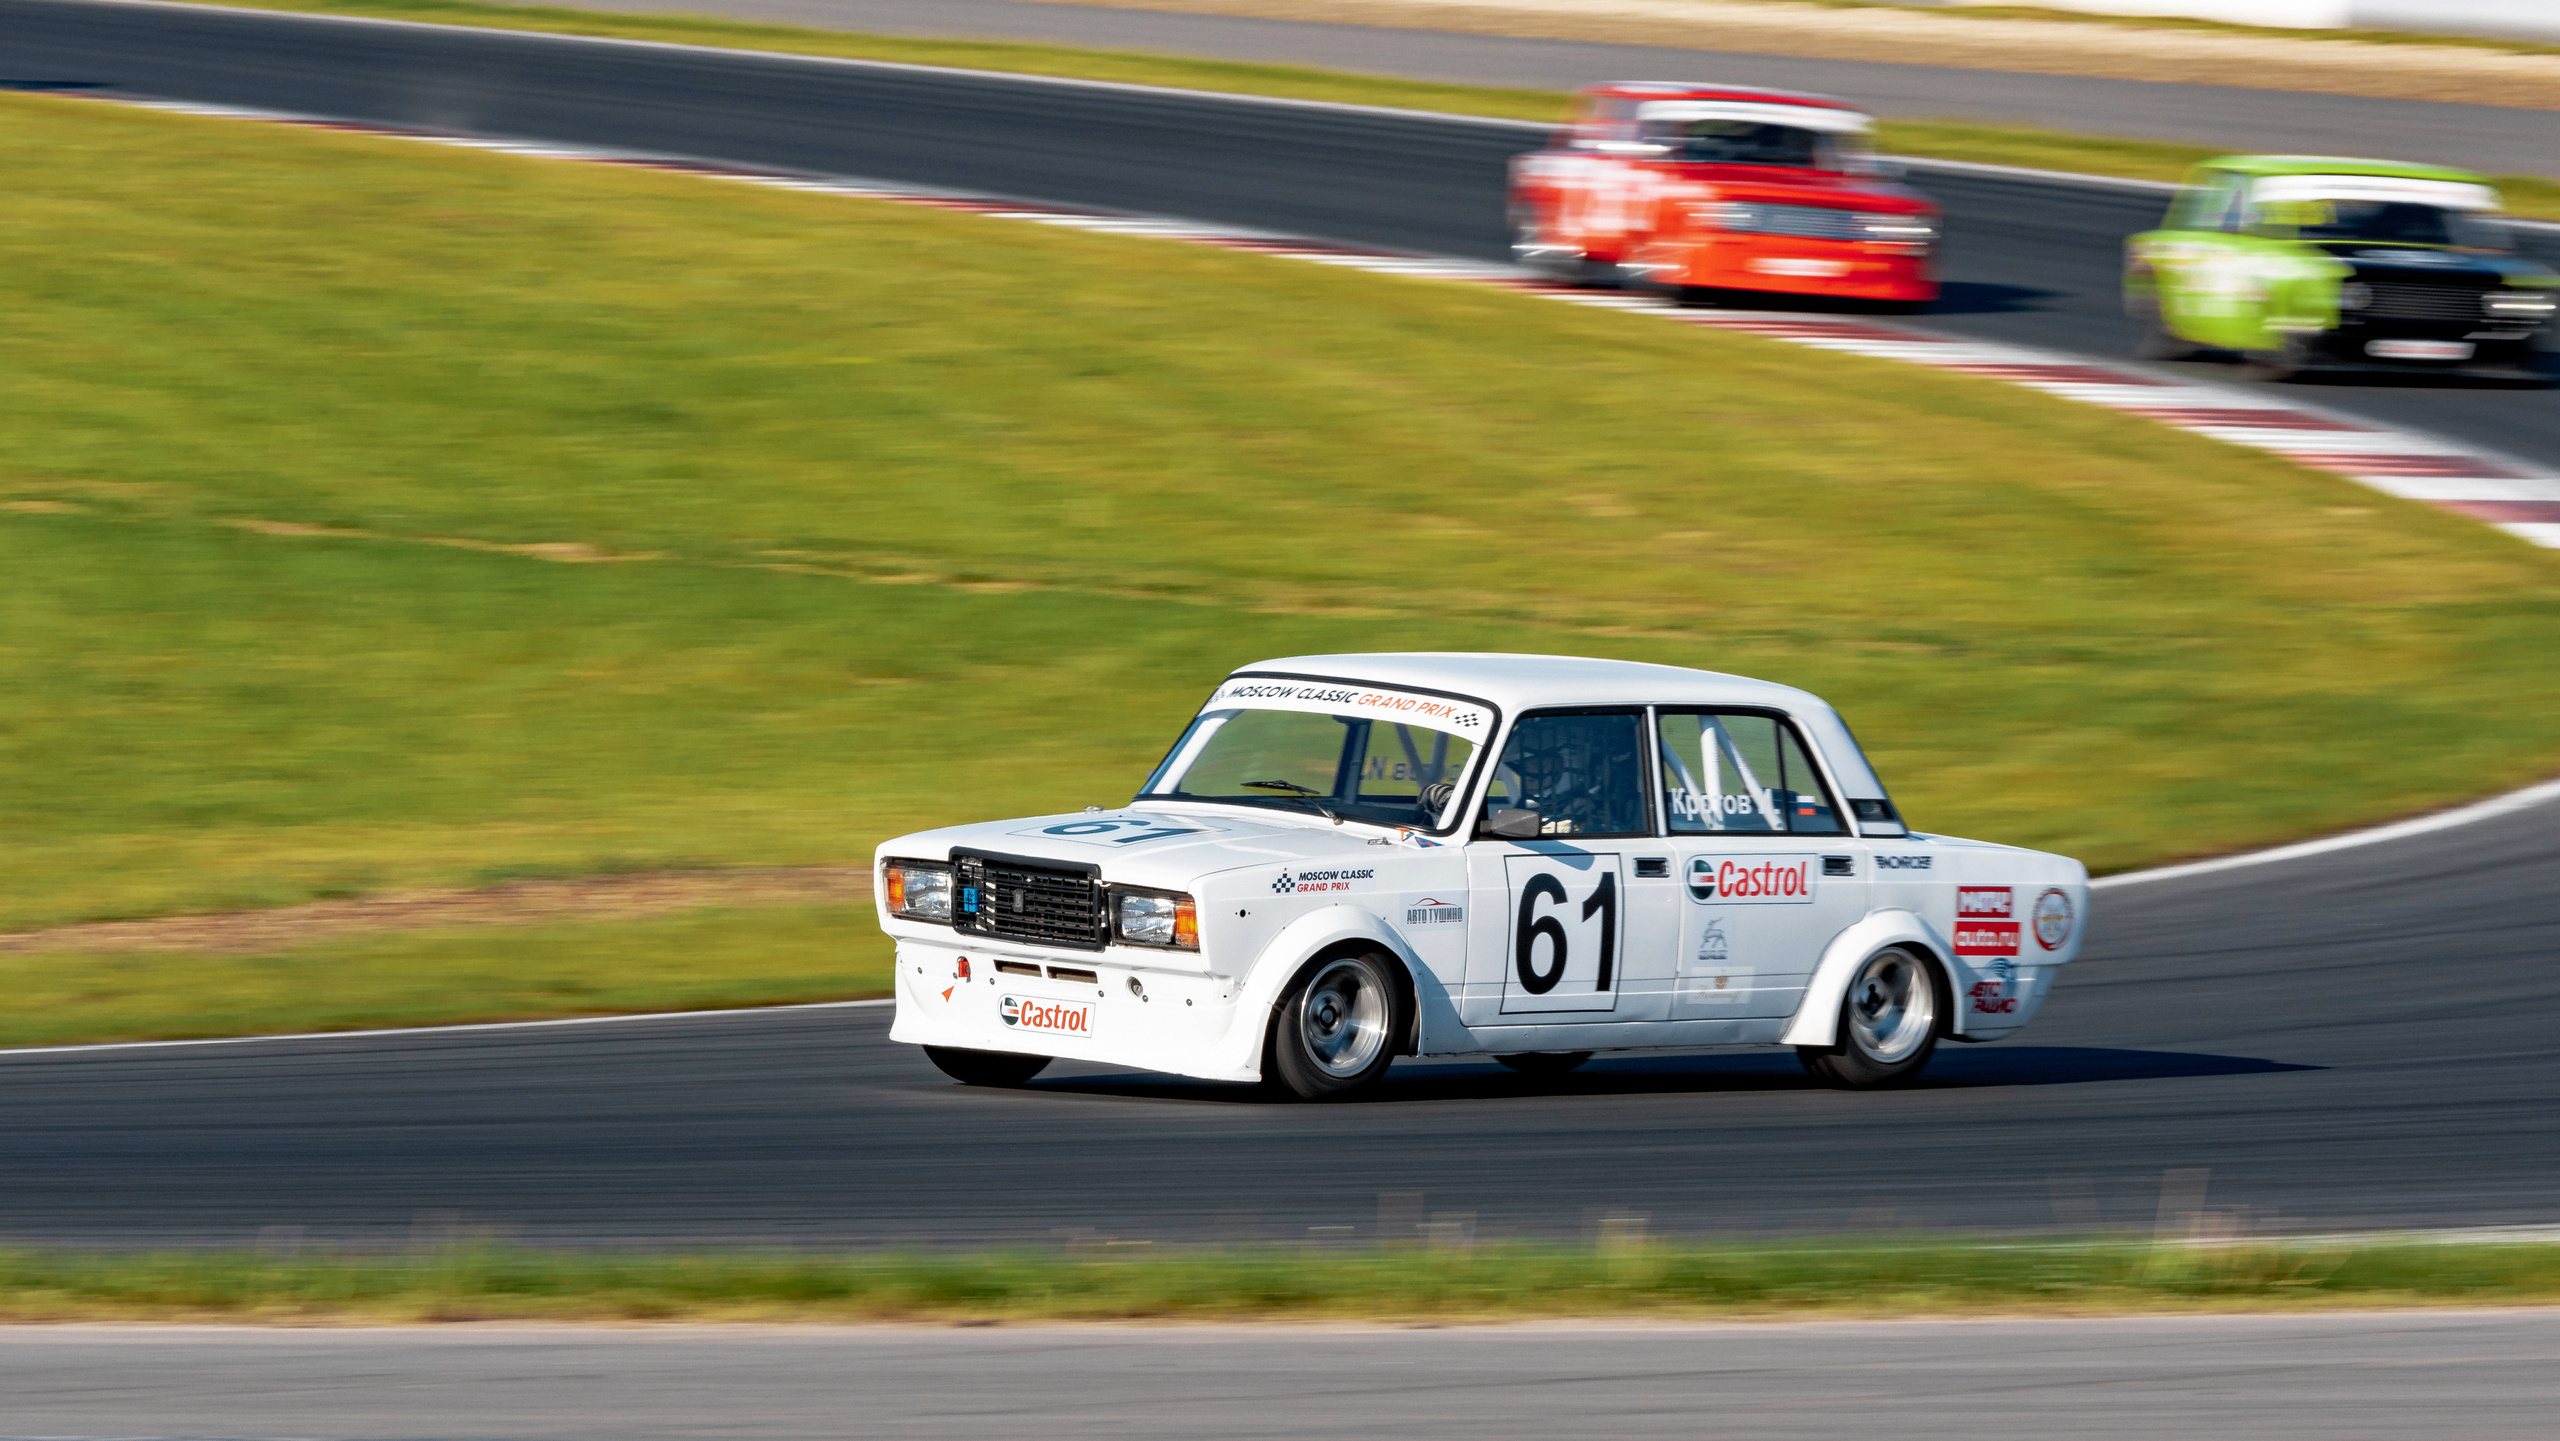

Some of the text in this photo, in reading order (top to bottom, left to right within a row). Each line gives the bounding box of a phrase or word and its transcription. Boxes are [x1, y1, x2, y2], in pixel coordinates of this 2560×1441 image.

[1229, 686, 1457, 718] MOSCOW CLASSIC GRAND PRIX
[1042, 820, 1202, 844] 61
[1297, 881, 1350, 893] GRAND PRIX
[1298, 869, 1374, 881] MOSCOW CLASSIC
[1719, 861, 1808, 898] Castrol
[1407, 908, 1427, 924] АВТО
[1516, 871, 1616, 995] 61
[1021, 1000, 1087, 1032] Castrol
